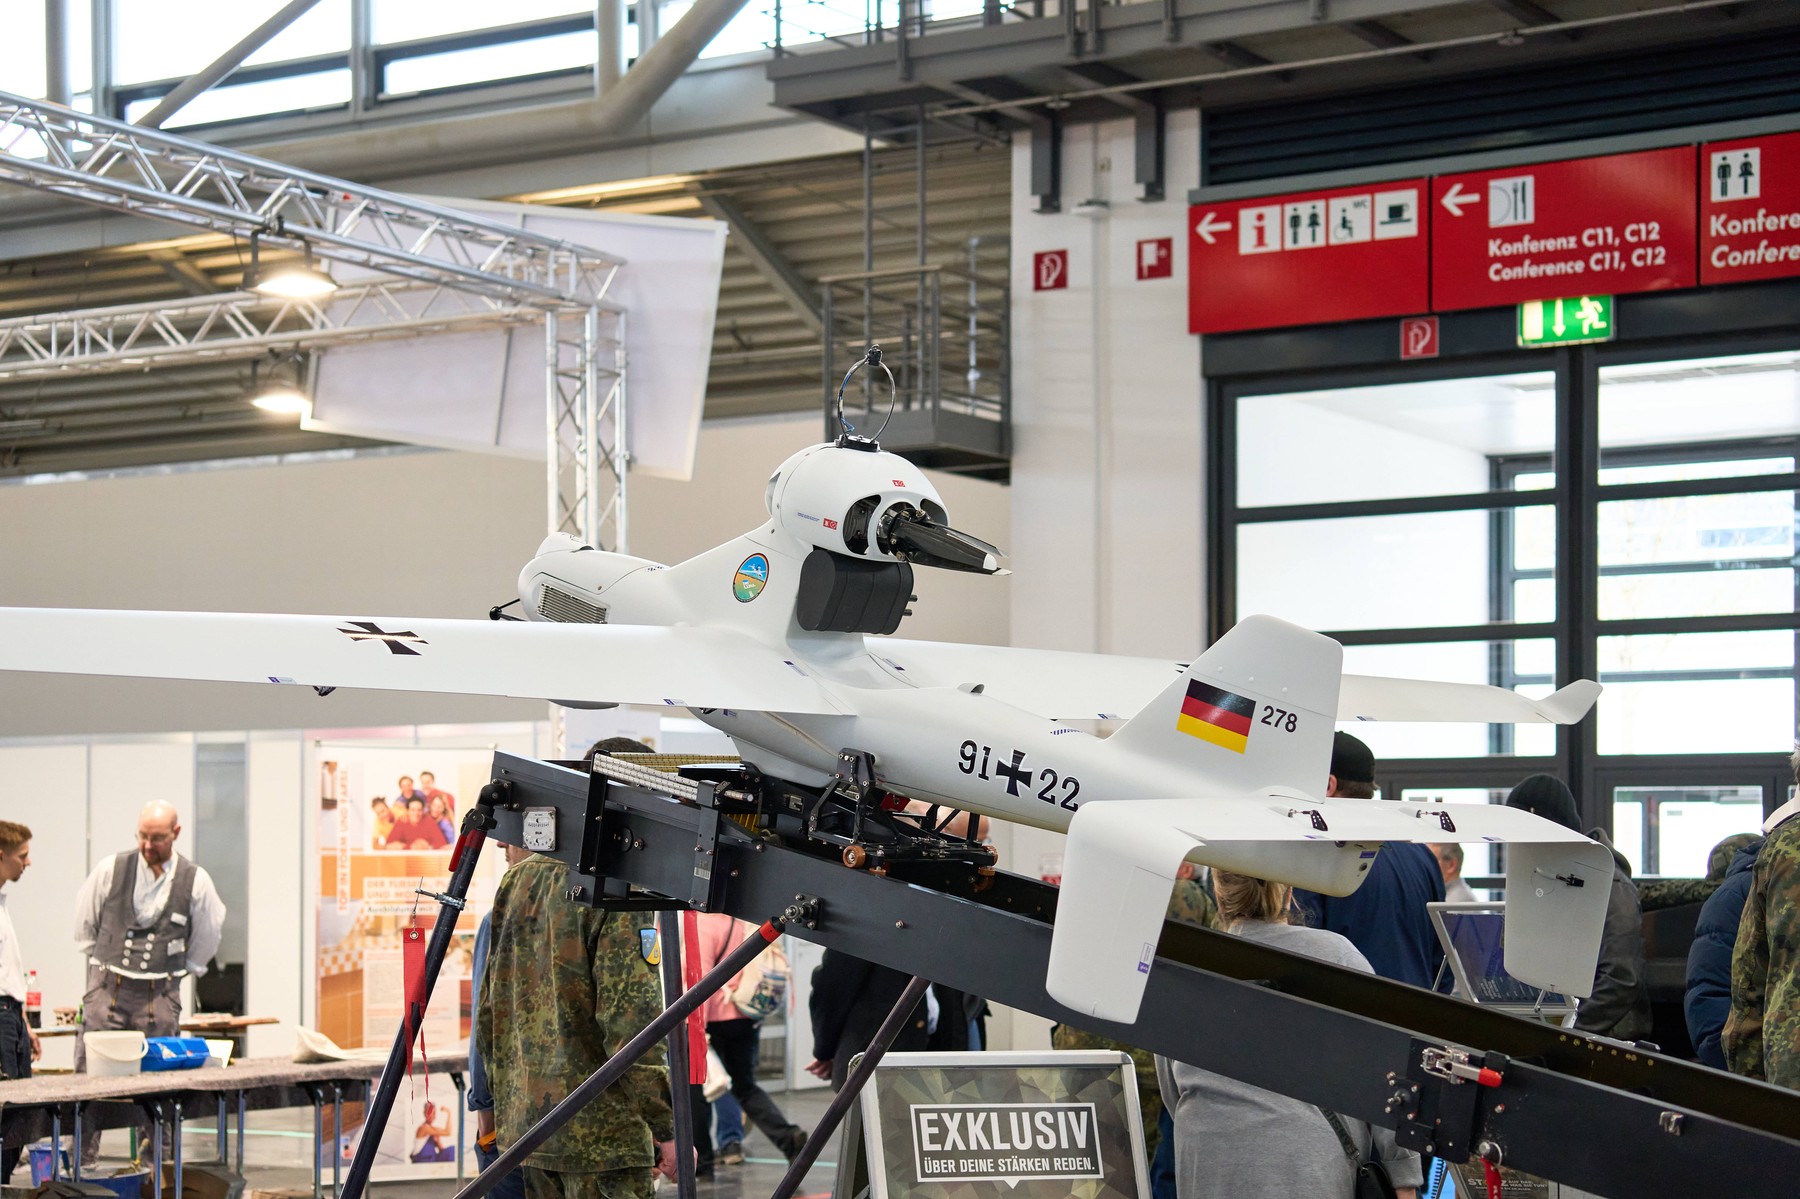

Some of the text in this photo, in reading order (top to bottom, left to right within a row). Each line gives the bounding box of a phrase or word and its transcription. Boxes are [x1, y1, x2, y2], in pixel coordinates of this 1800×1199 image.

[1710, 207, 1800, 237] Konfere
[1488, 221, 1660, 258] Konferenz C11, C12
[1711, 239, 1800, 269] Confere
[1488, 246, 1666, 282] Conference C11, C12
[1260, 705, 1298, 733] 278
[958, 739, 1081, 813] 91 22
[919, 1111, 1088, 1151] EXKLUSIV
[924, 1155, 1096, 1174] ÜBER DEINE STÄRKEN REDEN.
[1467, 1178, 1509, 1187] STZ
